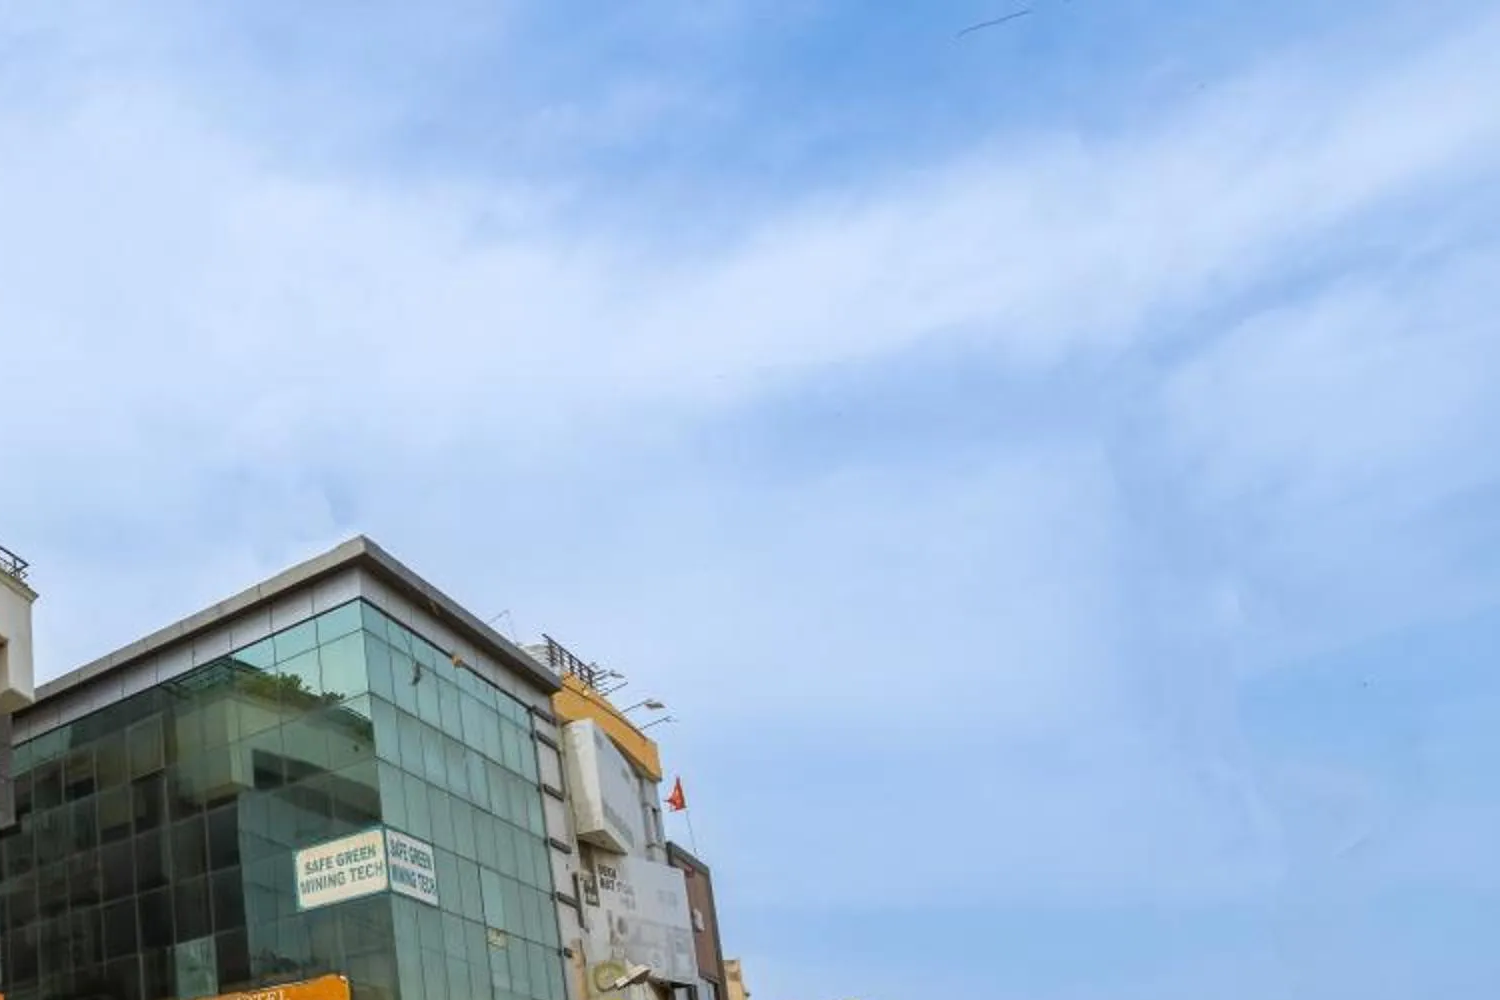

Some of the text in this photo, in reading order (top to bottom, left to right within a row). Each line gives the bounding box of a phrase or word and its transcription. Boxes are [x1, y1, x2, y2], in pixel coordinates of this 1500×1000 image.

[304, 844, 376, 875] SAFE GREEN
[300, 872, 346, 895] MINING
[350, 860, 384, 882] TECH
